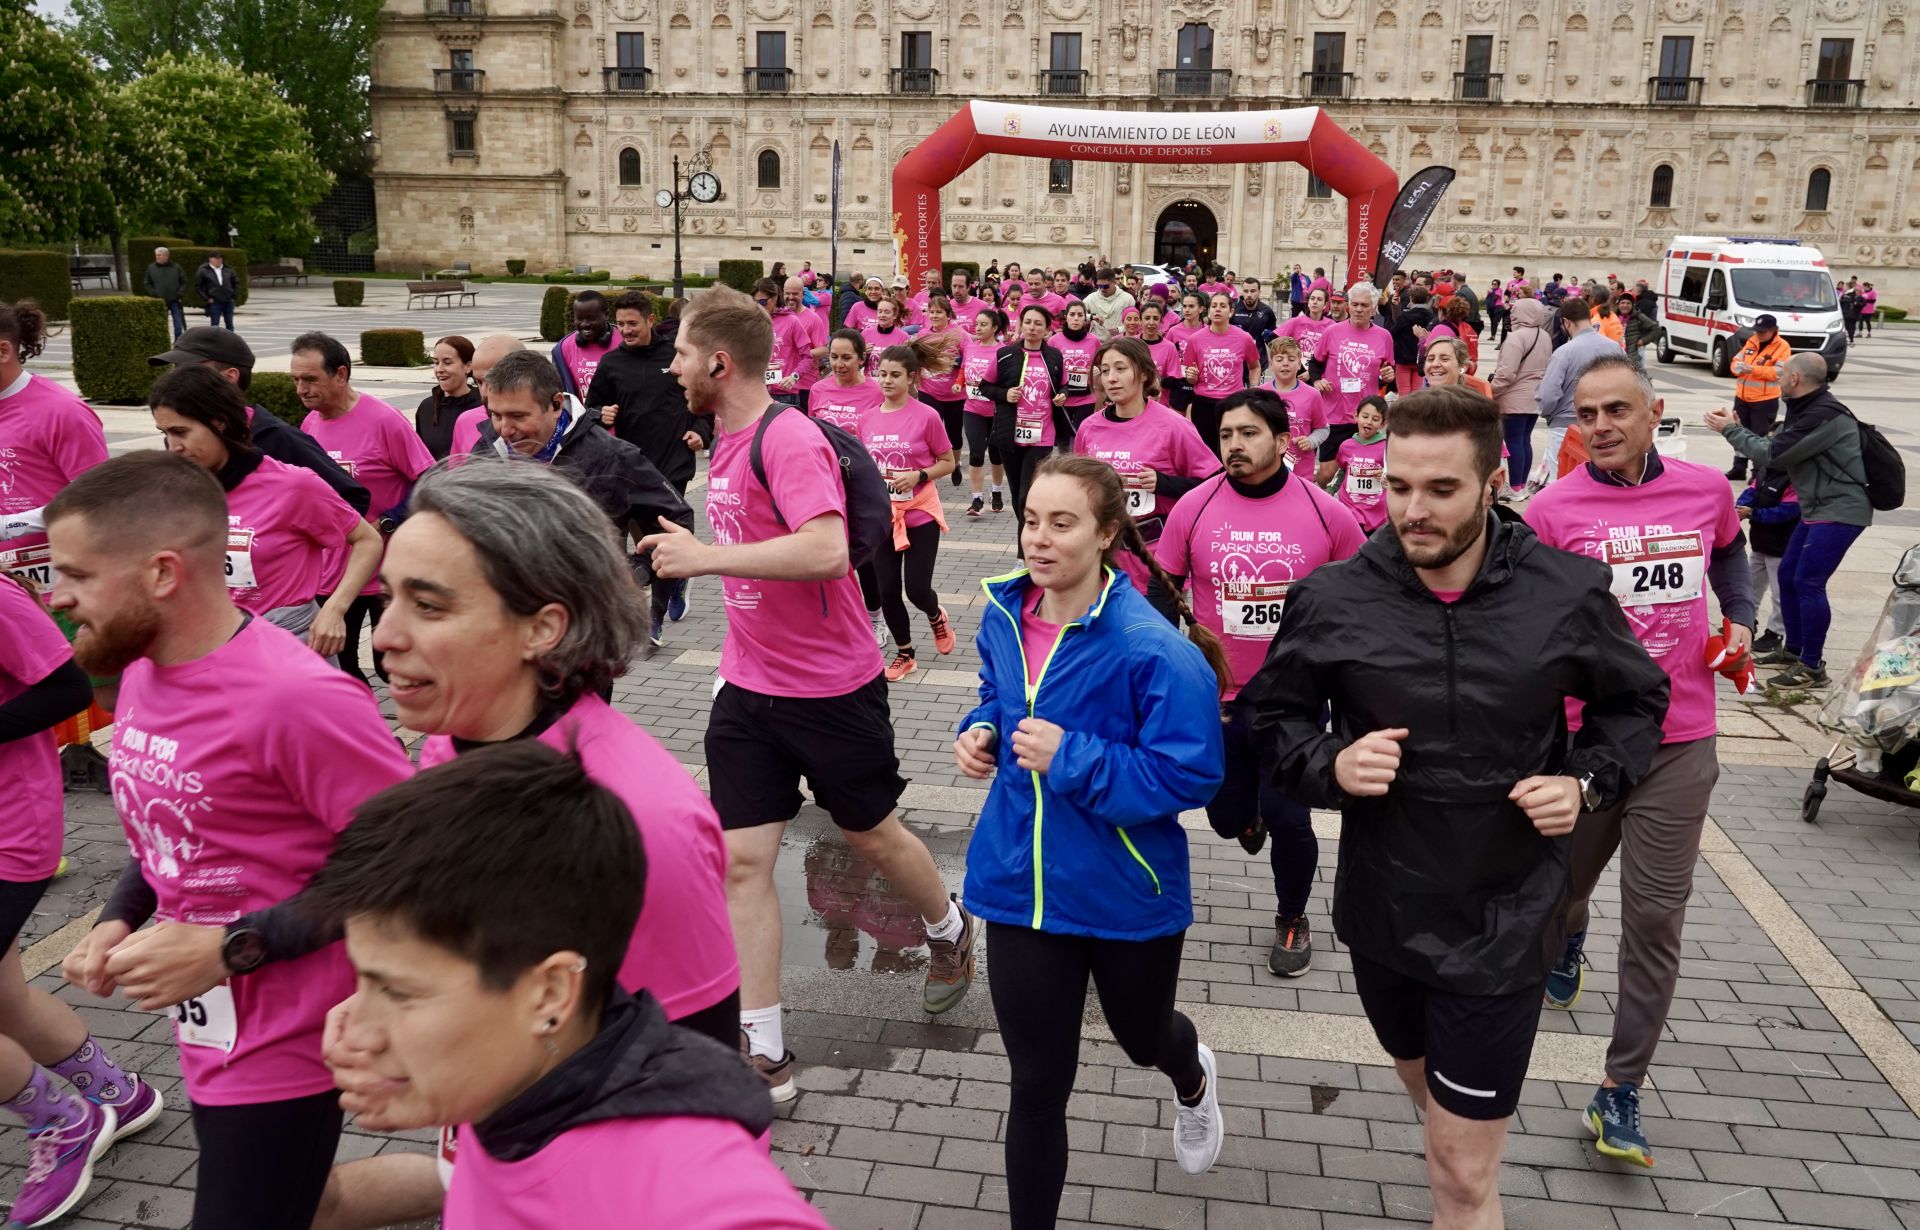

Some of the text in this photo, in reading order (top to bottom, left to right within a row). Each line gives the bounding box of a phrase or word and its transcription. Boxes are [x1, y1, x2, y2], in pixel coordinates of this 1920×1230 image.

[1048, 123, 1236, 140] AYUNTAMIENTO DE LEÓN
[1070, 143, 1212, 156] CONCEJALÍA DE DEPORTES
[917, 193, 928, 248] DEPORTES
[1358, 203, 1369, 261] DEPORTES
[919, 252, 929, 266] DE
[765, 372, 776, 381] 54
[1068, 374, 1082, 383] 140
[1016, 428, 1032, 440] 213
[1096, 451, 1131, 460] RUN FOR
[1356, 478, 1372, 490] 118
[1129, 491, 1141, 508] 3
[228, 515, 242, 526] OR
[1230, 530, 1282, 543] RUN FOR
[1608, 525, 1640, 539] RUN
[1210, 541, 1303, 555] PARKINSON'S
[1611, 537, 1643, 554] RUN
[1660, 544, 1698, 552] PARKINSON
[14, 565, 50, 585] 47
[1632, 562, 1684, 593] 248
[1228, 583, 1252, 594] RUN
[1241, 603, 1282, 625] 256
[122, 726, 180, 763] RUN FOR
[109, 748, 205, 795] ARKINSON'S
